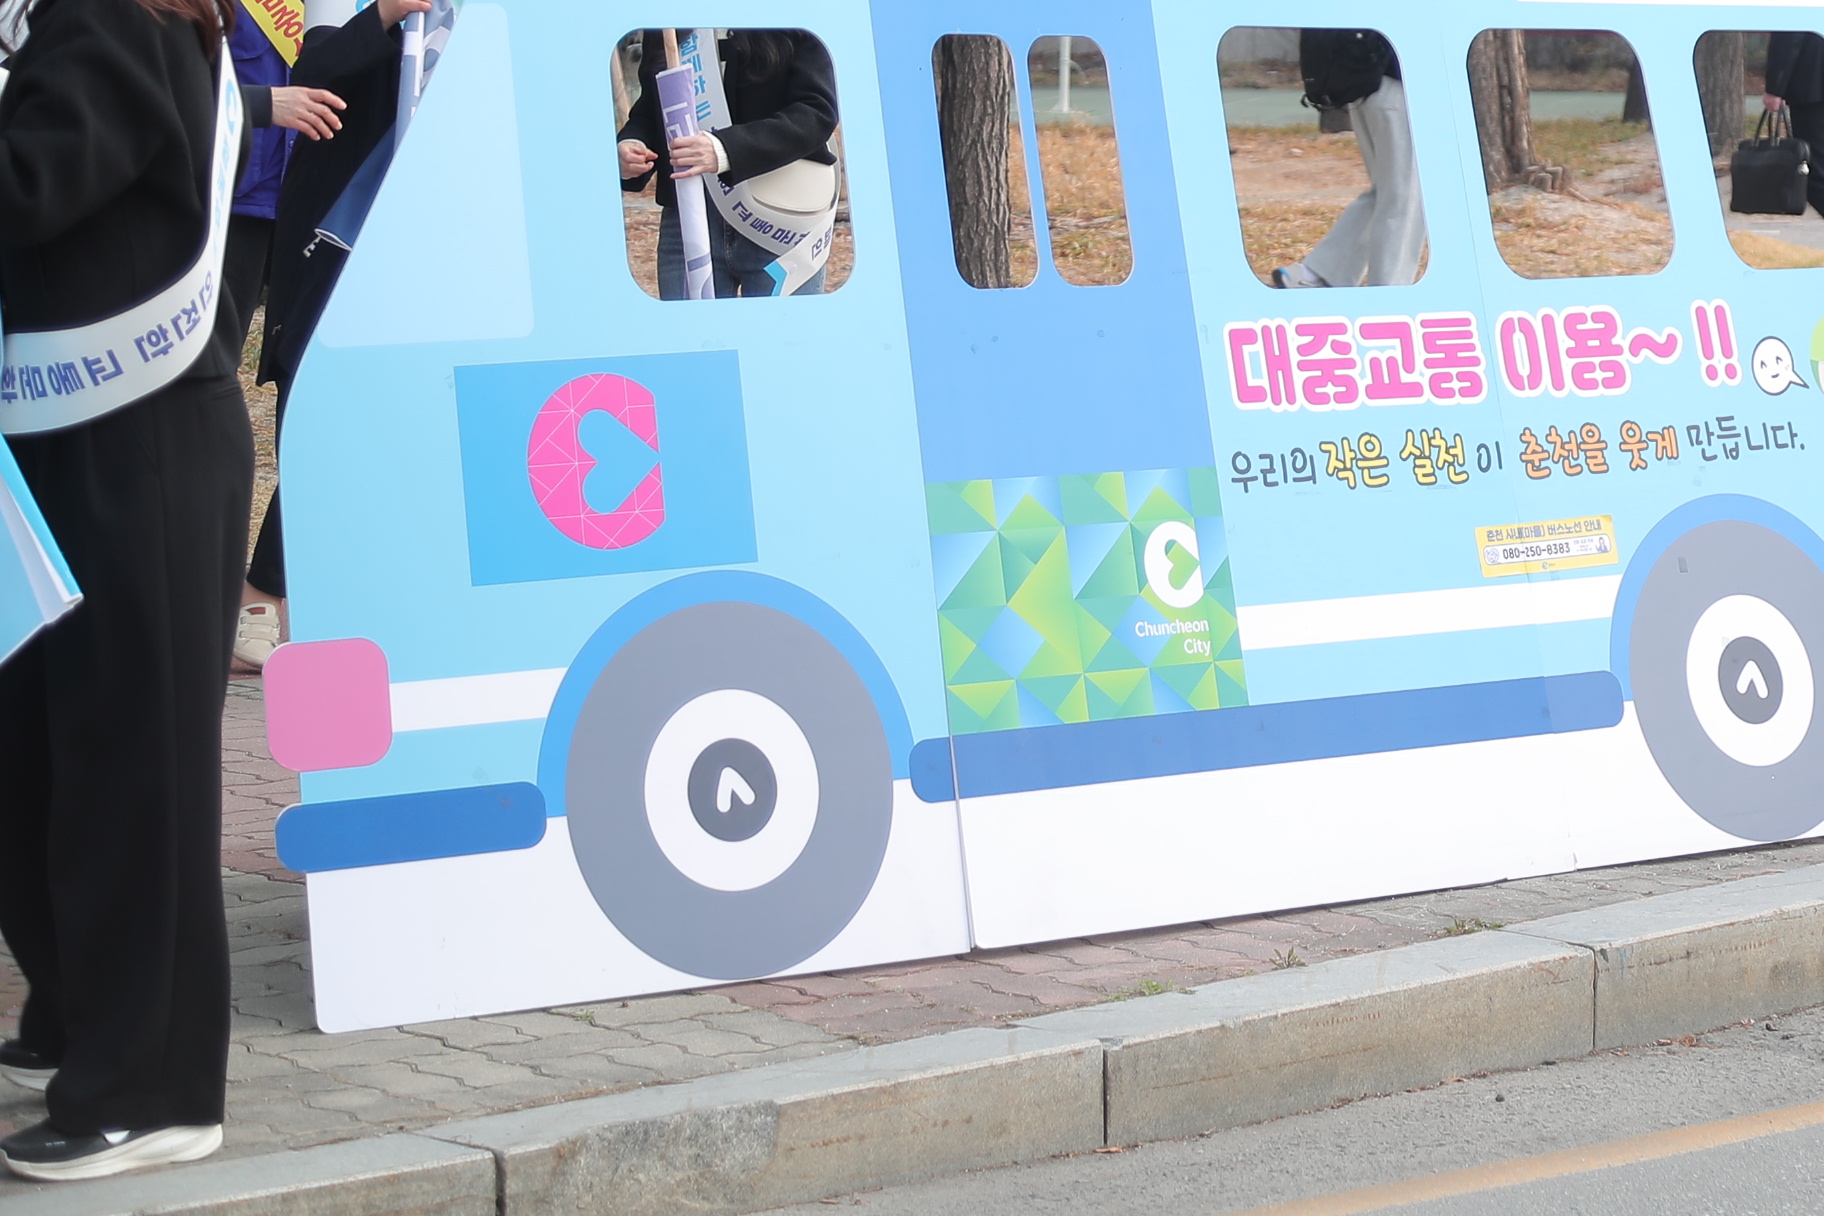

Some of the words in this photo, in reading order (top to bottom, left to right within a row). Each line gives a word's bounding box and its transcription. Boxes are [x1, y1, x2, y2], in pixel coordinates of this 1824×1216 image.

[1227, 313, 1486, 408] 대중교통
[1230, 445, 1318, 494] 우리의
[1319, 432, 1390, 489] 작은
[1518, 420, 1608, 481] 춘천을
[1619, 420, 1679, 470] 웃게
[1686, 415, 1806, 463] 만듭니다.
[1487, 529, 1503, 542] 춘천
[1548, 521, 1582, 535] 버스노선
[1584, 519, 1602, 531] 안내
[1502, 542, 1571, 560] 080-250-8383
[1135, 619, 1209, 637] Chuncheon
[1184, 638, 1211, 657] City
